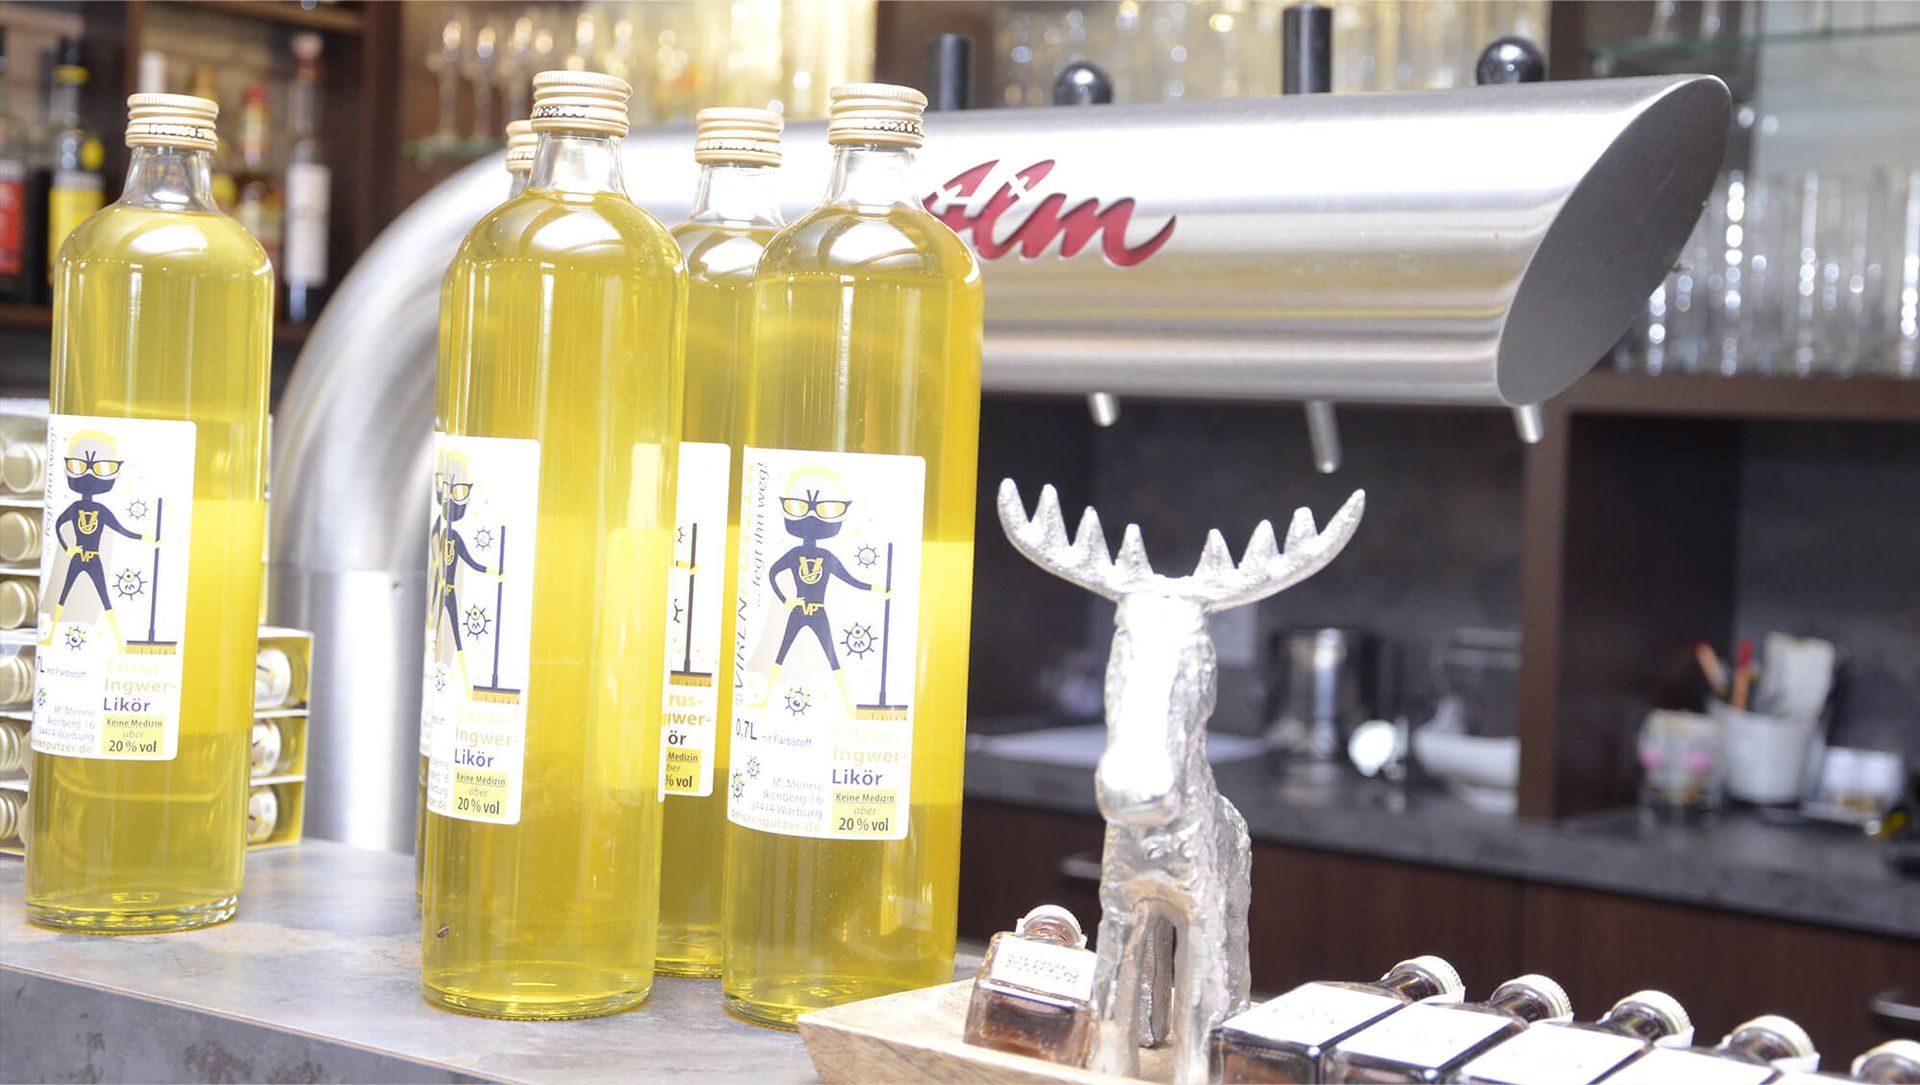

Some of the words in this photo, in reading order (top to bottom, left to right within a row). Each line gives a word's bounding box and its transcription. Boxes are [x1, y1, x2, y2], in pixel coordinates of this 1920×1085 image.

[756, 461, 769, 509] weg!
[753, 513, 765, 546] ihn
[751, 547, 764, 588] fegt
[104, 677, 176, 695] Ingwer-
[103, 697, 151, 713] Likör
[106, 717, 129, 727] Keine
[131, 718, 163, 728] Medizin
[122, 730, 144, 739] aber
[455, 725, 520, 748] Ingwer-
[772, 735, 812, 748] Farbstoff
[108, 739, 123, 753] 20
[125, 741, 137, 753] %
[139, 740, 157, 753] vol
[454, 748, 494, 767] Likör
[667, 752, 699, 762] Medizin
[833, 746, 908, 767] Ingwer-
[456, 773, 474, 783] Keine
[476, 775, 506, 787] Medizin
[676, 775, 693, 788] vol
[832, 769, 883, 786] Likör
[457, 797, 469, 811] 20
[470, 799, 481, 813] %
[483, 801, 500, 815] vol
[835, 793, 860, 803] Keine
[862, 794, 895, 804] Medizin
[776, 804, 823, 822] Warburg
[853, 806, 877, 816] aber
[838, 818, 855, 831] 20
[856, 818, 869, 831] %
[871, 818, 889, 831] vol
